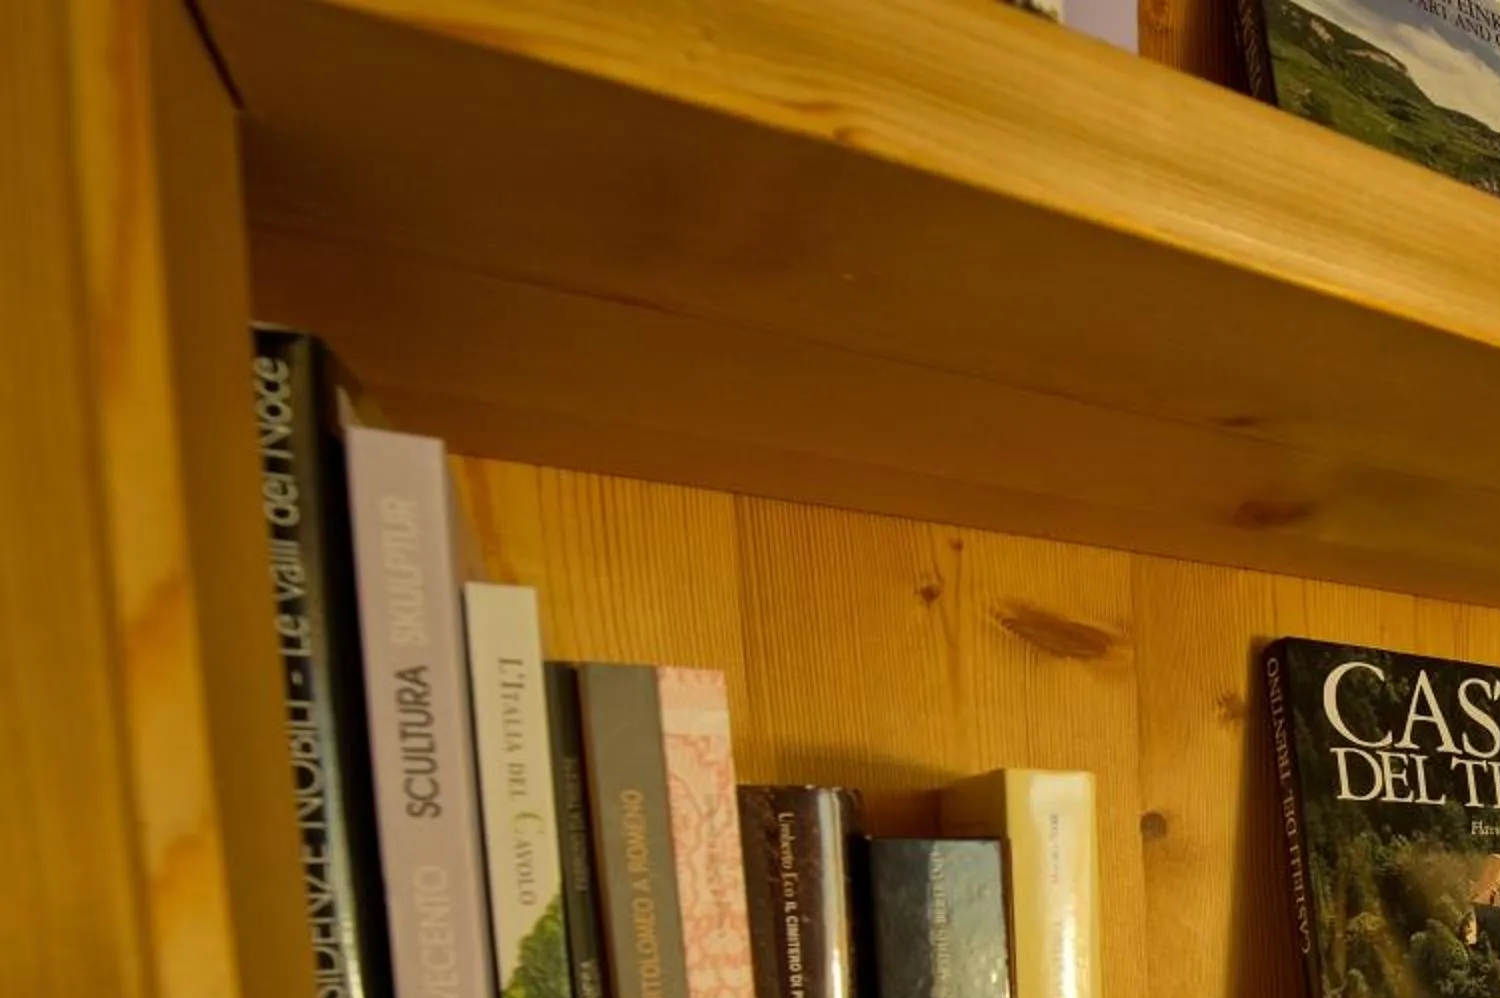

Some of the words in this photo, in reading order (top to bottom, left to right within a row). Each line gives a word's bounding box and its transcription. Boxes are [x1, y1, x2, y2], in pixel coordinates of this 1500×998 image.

[1454, 13, 1491, 42] AND
[252, 356, 297, 460] Noce
[380, 492, 431, 648] SKULPTUR
[274, 613, 313, 658] Le
[498, 656, 525, 753] L'ITALIA
[1266, 656, 1293, 784] TRENTINO
[395, 662, 445, 821] SCULTURA
[507, 761, 528, 798] DEL
[1328, 746, 1448, 808] DEL
[618, 787, 650, 873] ROMENO
[1283, 788, 1299, 838] DEL
[510, 810, 545, 907] CAVOLO
[781, 872, 801, 899] Eco
[783, 900, 799, 914] IL
[1288, 842, 1311, 955] CASTELLI
[785, 914, 804, 973] CIMITERO
[789, 974, 804, 988] DI
